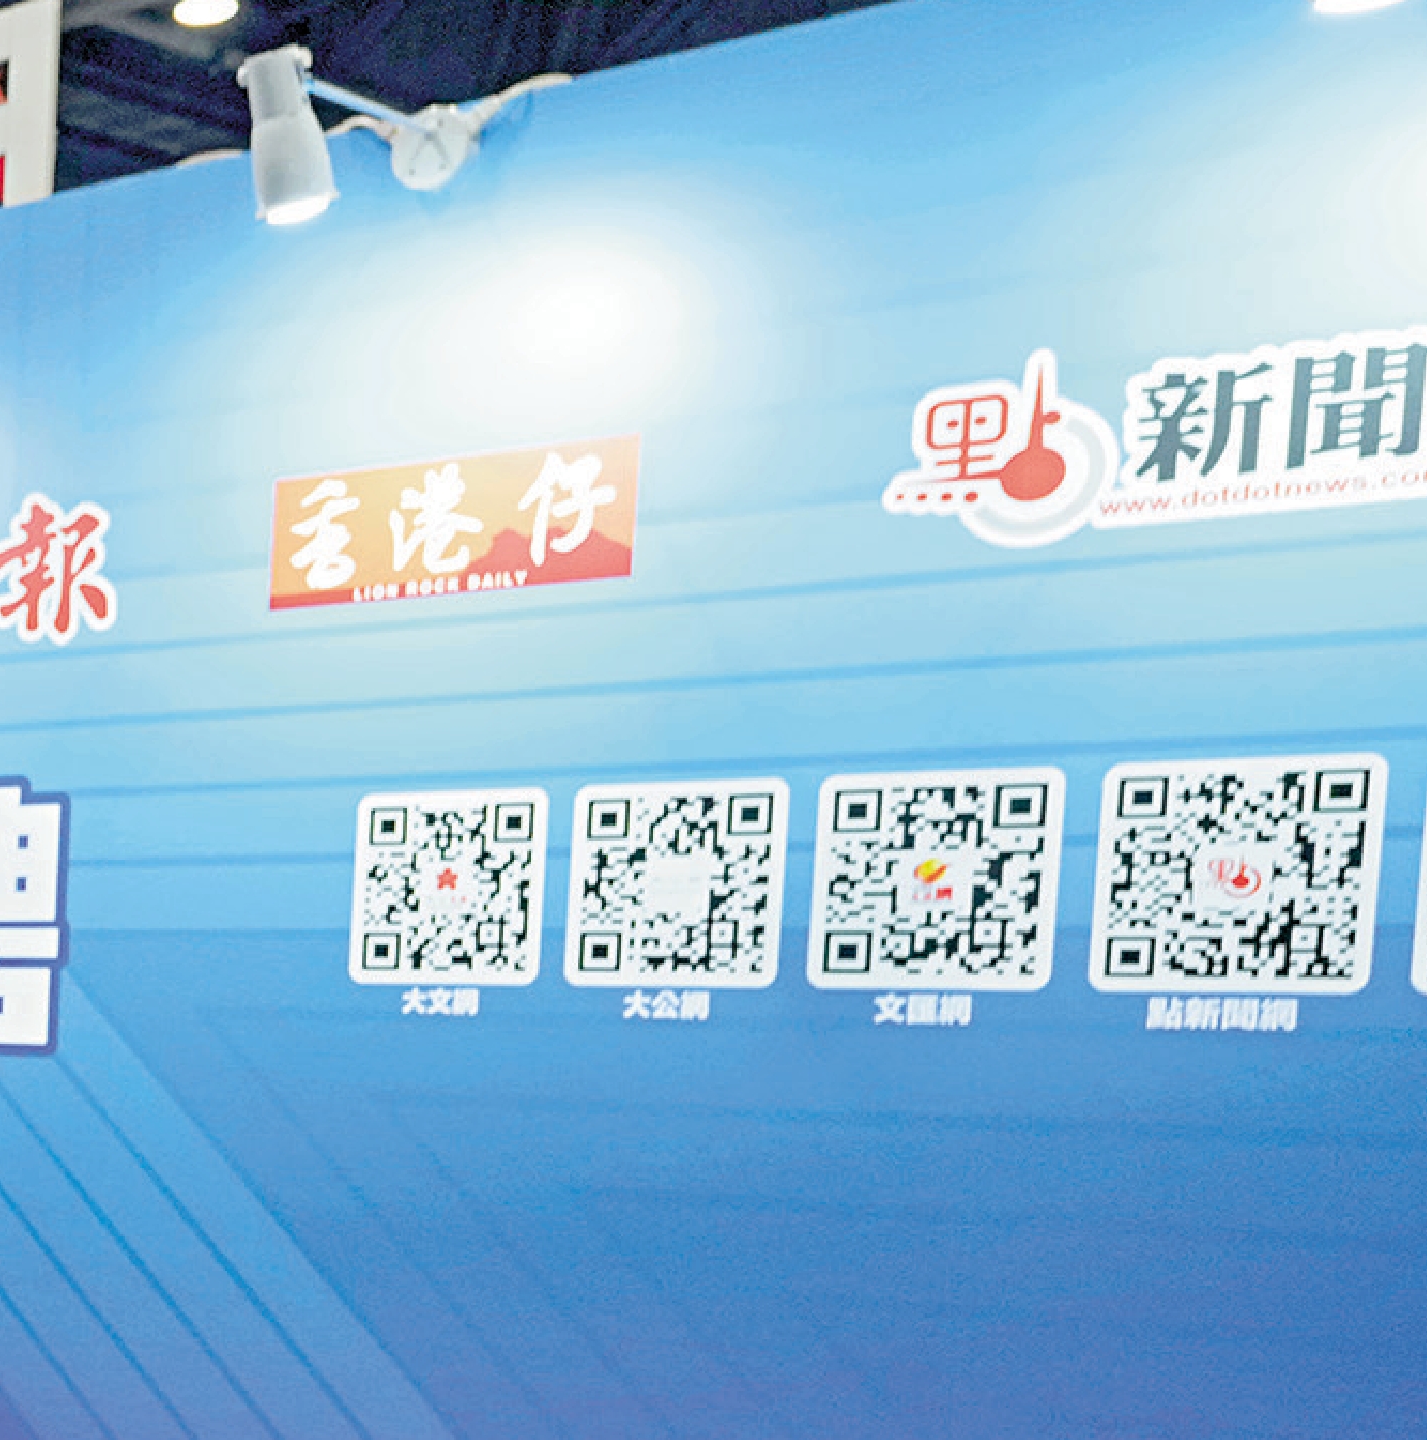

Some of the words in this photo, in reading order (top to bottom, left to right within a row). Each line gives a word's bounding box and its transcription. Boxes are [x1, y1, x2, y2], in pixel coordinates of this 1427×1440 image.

[1100, 469, 1427, 516] www.dotdotnews.co
[289, 452, 617, 589] 香港仔
[353, 582, 399, 602] LION
[404, 576, 459, 598] ROCK
[466, 569, 528, 591] DAILY
[622, 989, 711, 1021] 大公網
[873, 991, 973, 1027] 文匯網
